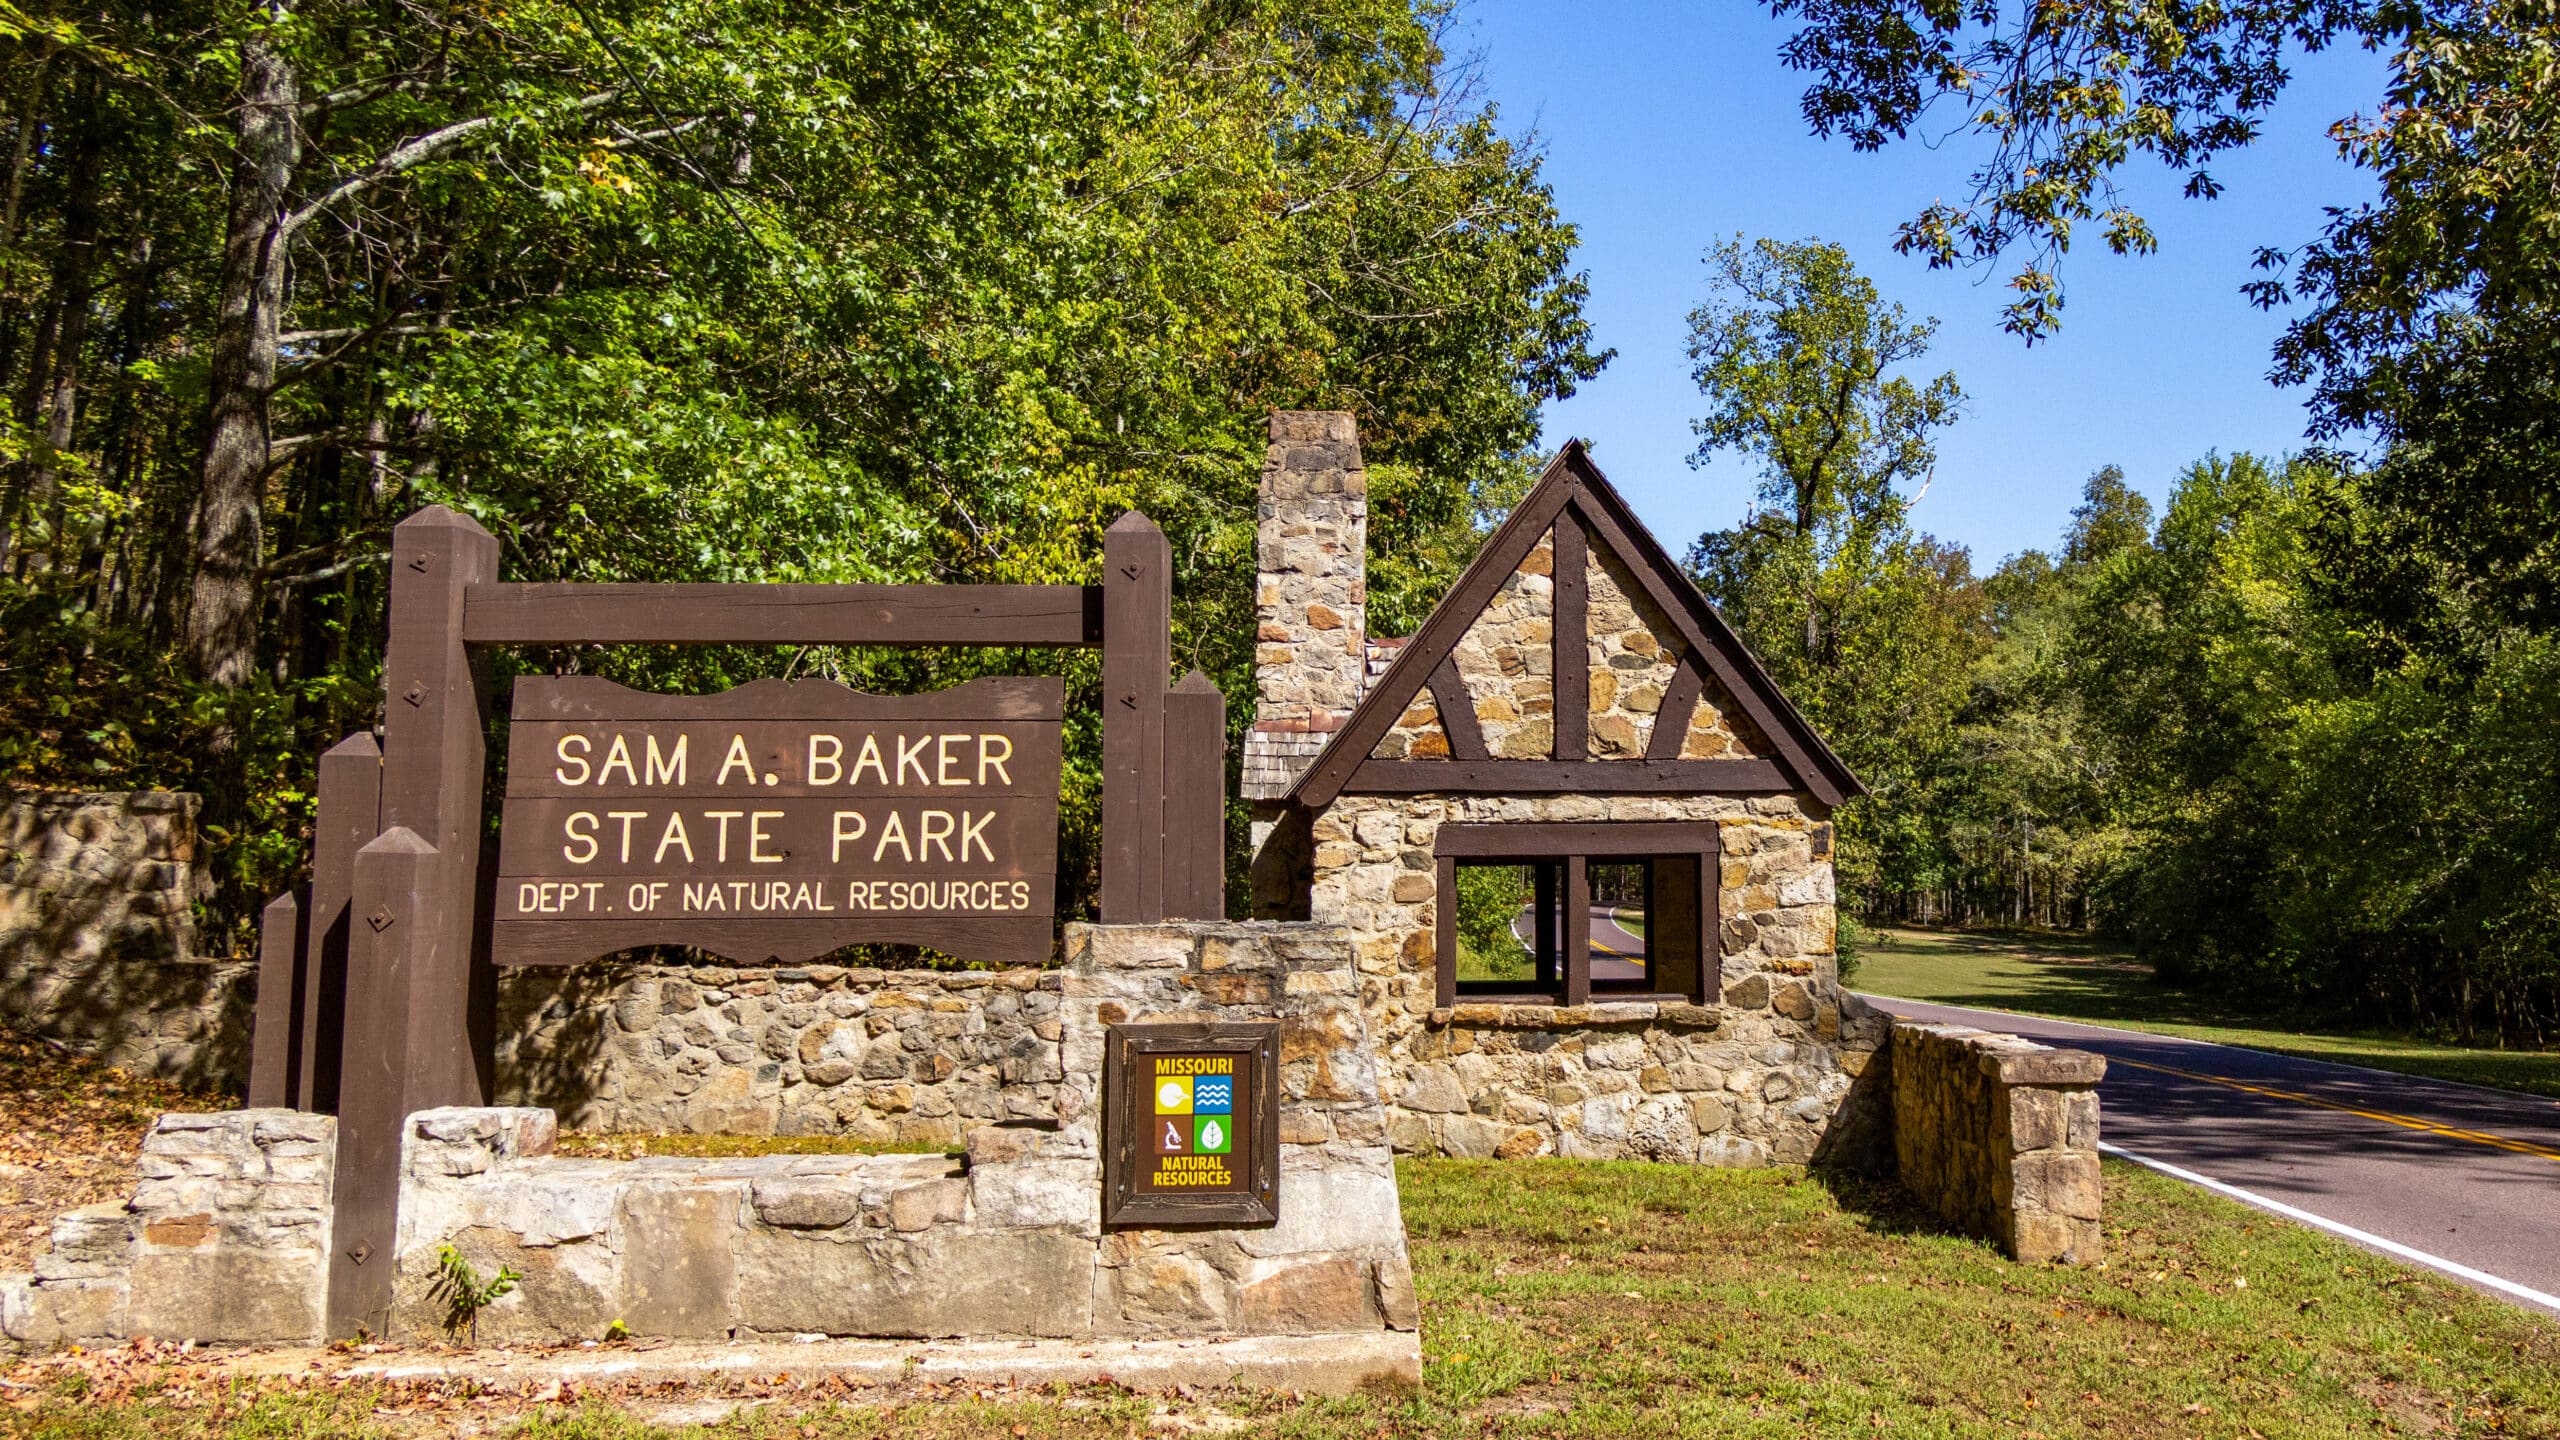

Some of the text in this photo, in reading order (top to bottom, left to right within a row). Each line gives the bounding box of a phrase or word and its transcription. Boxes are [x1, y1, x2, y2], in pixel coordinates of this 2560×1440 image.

[555, 733, 1014, 788] SAM A. BAKER
[563, 810, 997, 864] STATE PARK
[518, 880, 1030, 913] DEPT. OF NATURAL RESOURCES
[1155, 1058, 1233, 1074] MISSOURI
[1162, 1156, 1224, 1171] NATURAL
[1153, 1171, 1231, 1186] RESOURCES
